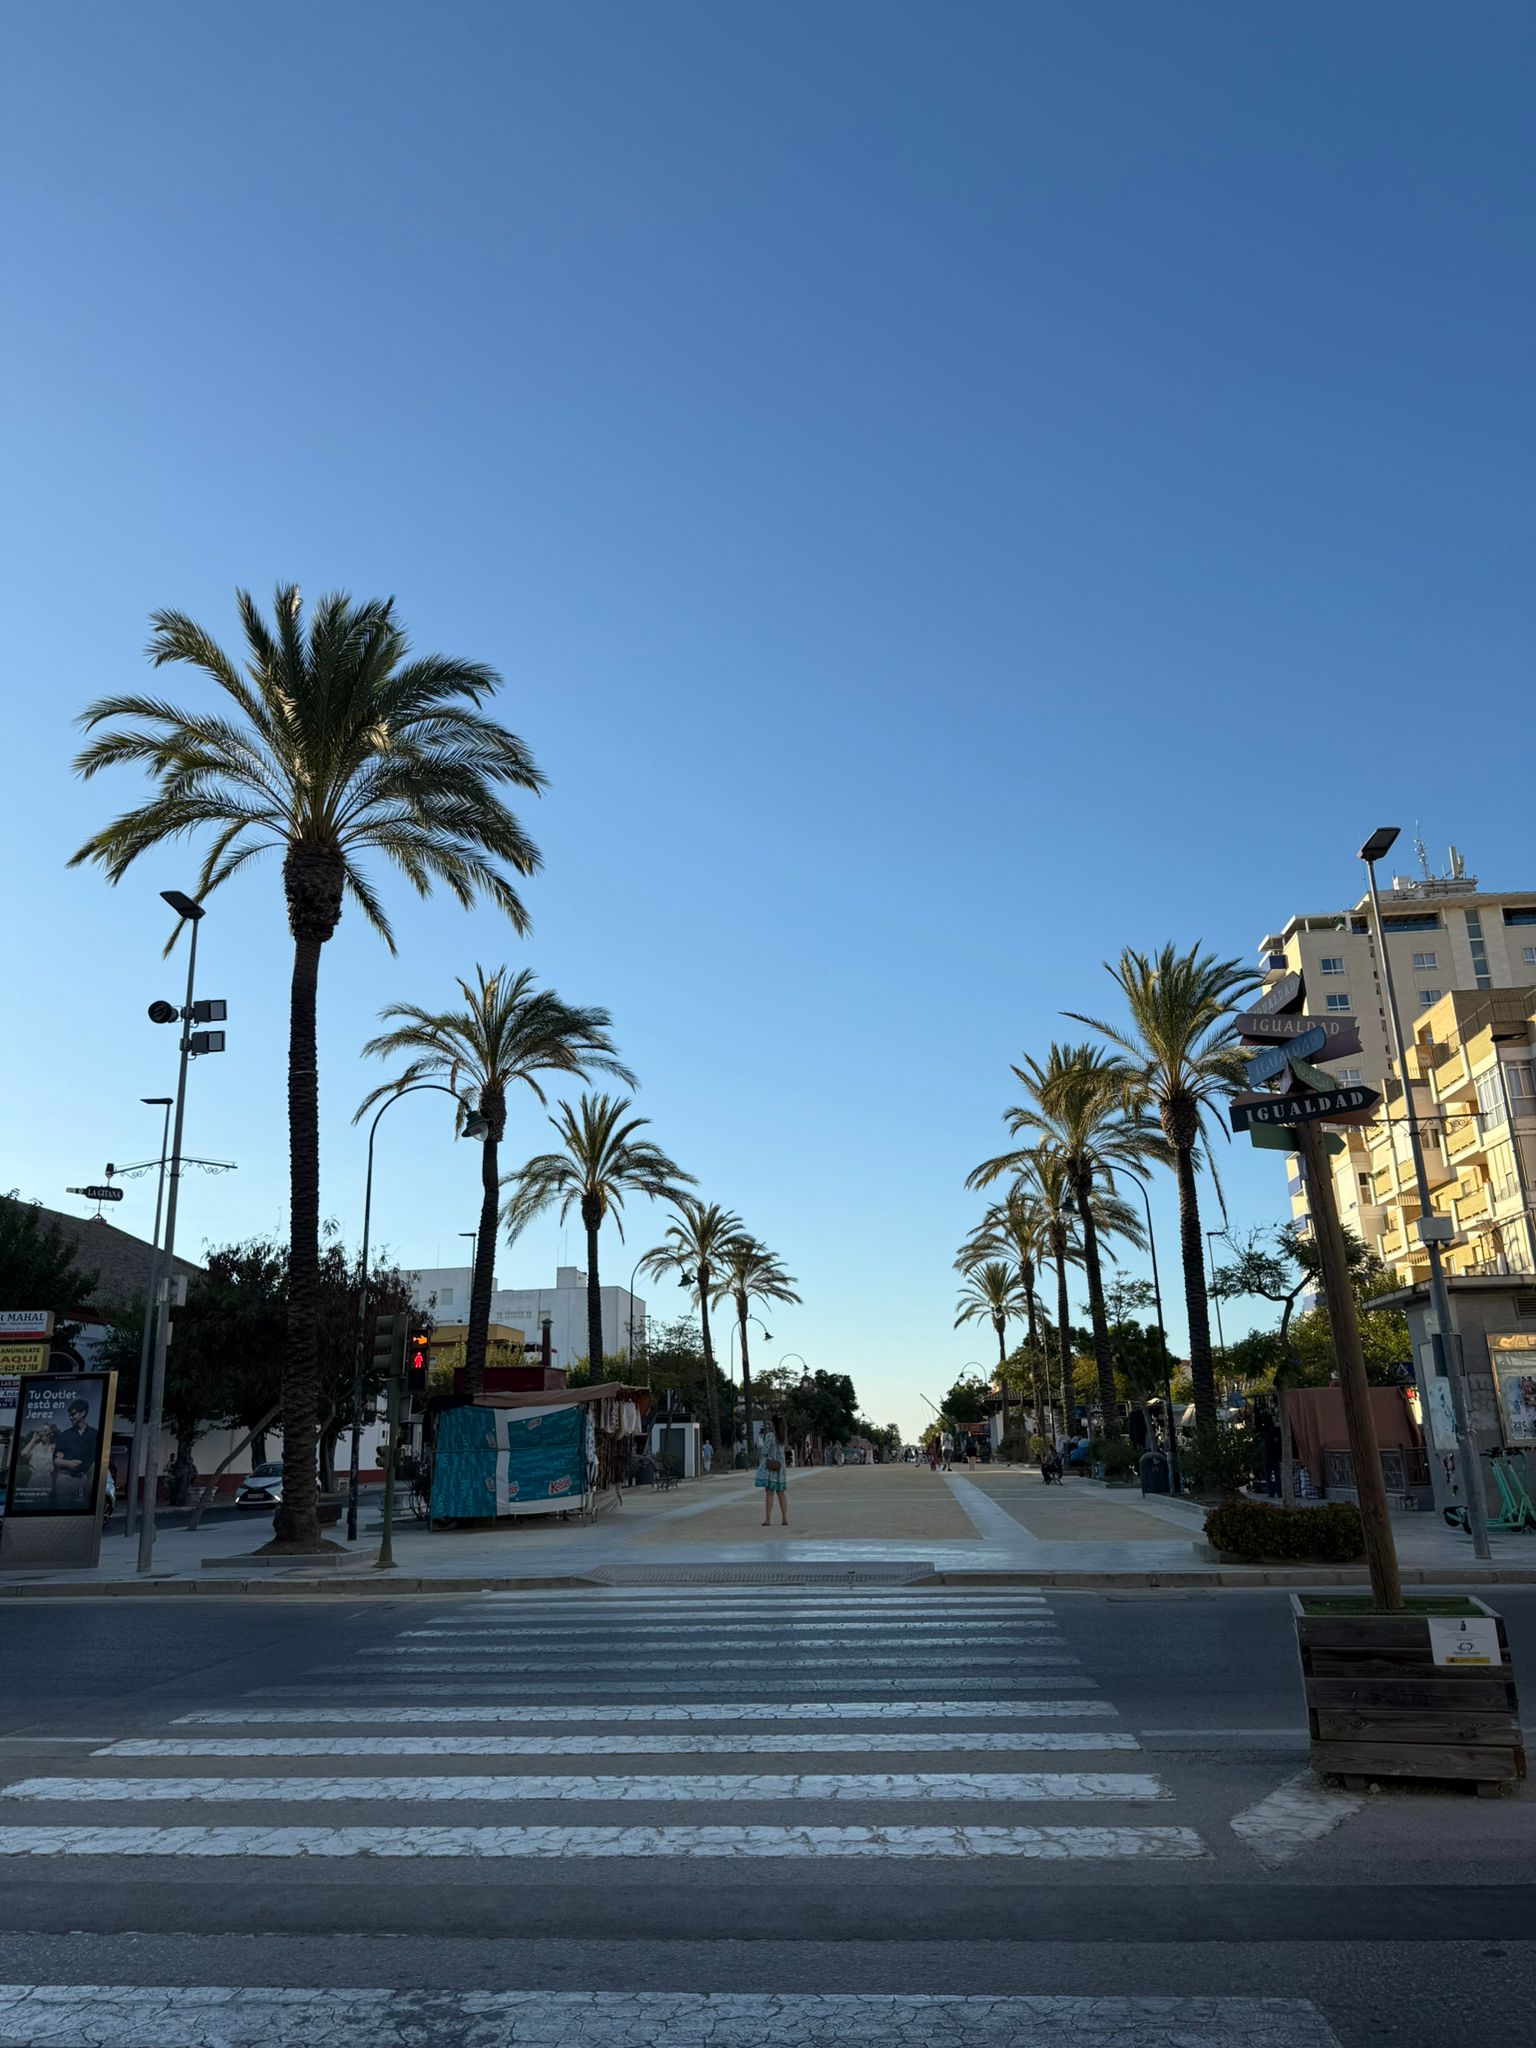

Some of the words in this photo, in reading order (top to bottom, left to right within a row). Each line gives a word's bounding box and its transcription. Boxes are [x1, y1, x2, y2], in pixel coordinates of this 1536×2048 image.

[1246, 1091, 1364, 1122] IGUALDAD
[88, 1188, 97, 1196] LA
[7, 1313, 45, 1321] MAHAL
[28, 1390, 41, 1399] Tu
[43, 1390, 77, 1399] Outlet
[27, 1400, 50, 1409] está
[52, 1401, 65, 1409] en
[25, 1409, 54, 1419] Jerez
